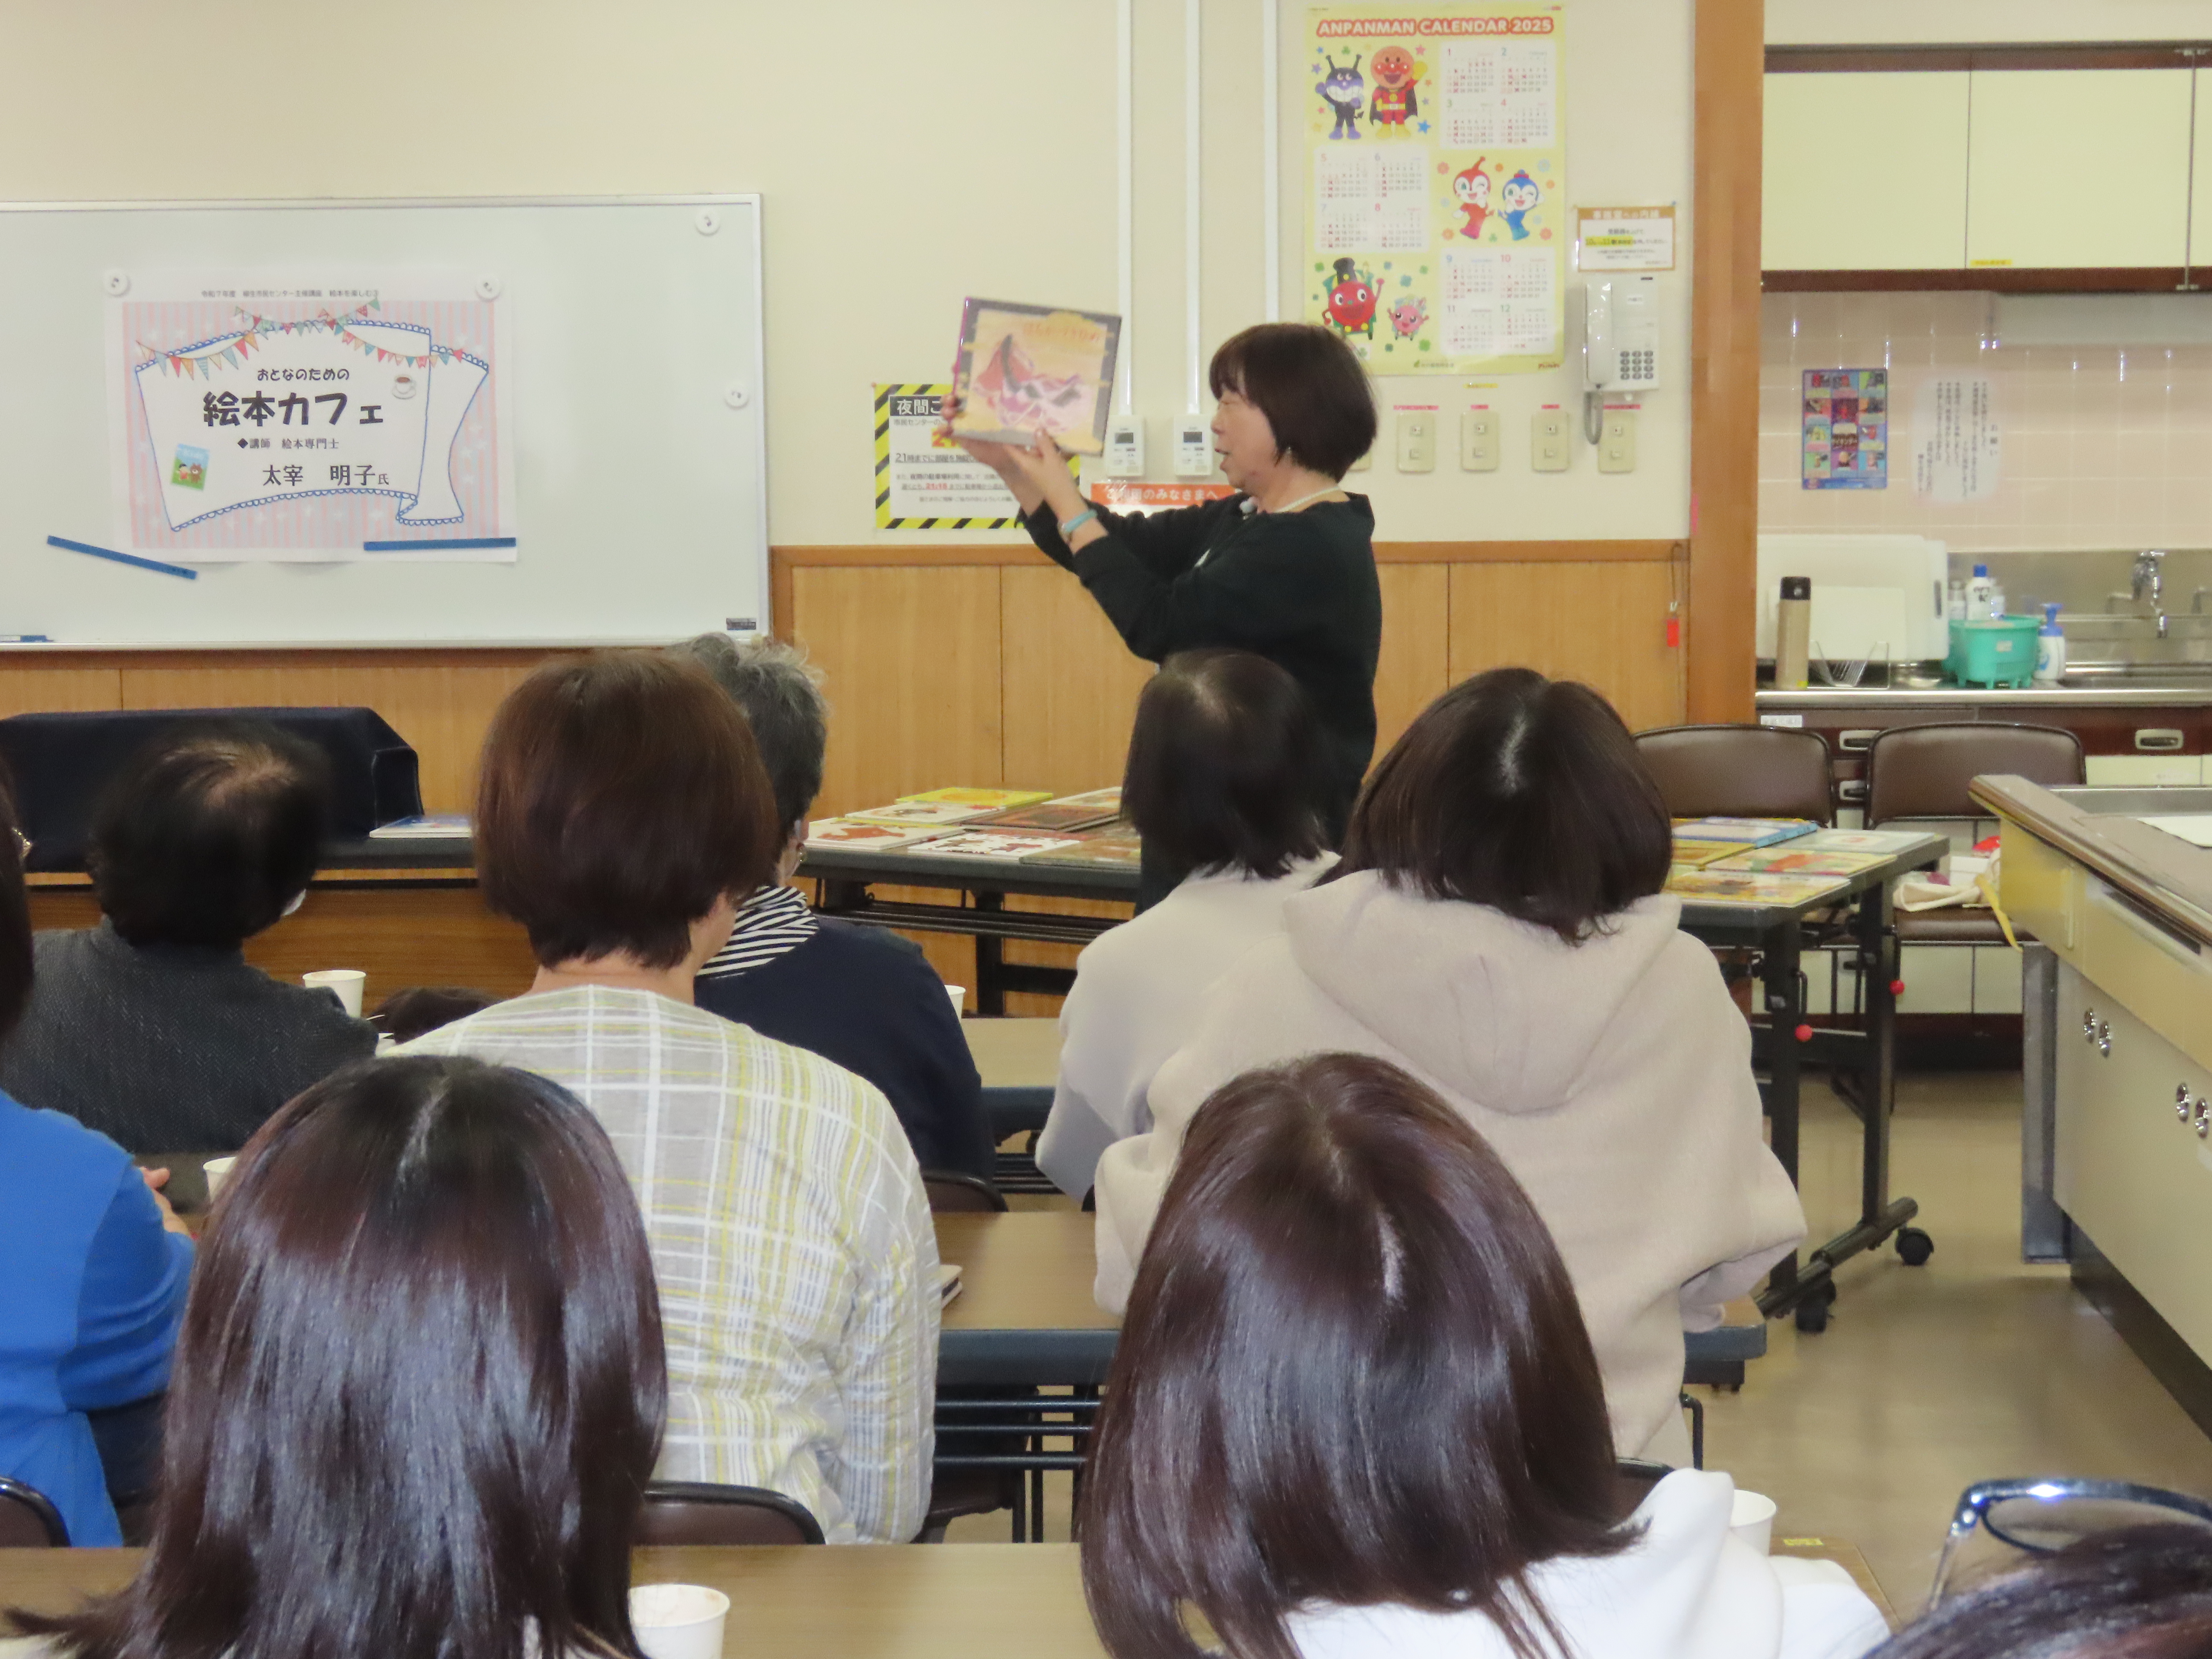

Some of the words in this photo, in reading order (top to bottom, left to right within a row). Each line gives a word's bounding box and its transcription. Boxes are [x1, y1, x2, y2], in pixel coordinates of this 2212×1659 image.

[1319, 19, 1416, 35] ANPANMAN
[1420, 18, 1508, 34] CALENDAR
[1511, 17, 1552, 33] 2025
[1501, 254, 1511, 262] 10
[1501, 304, 1511, 313] 12
[257, 368, 349, 381] おとなのための
[203, 390, 383, 427] 絵本カフェ
[250, 438, 270, 449] 講師
[282, 438, 339, 449] 絵本専門士
[263, 464, 303, 486] 太宰
